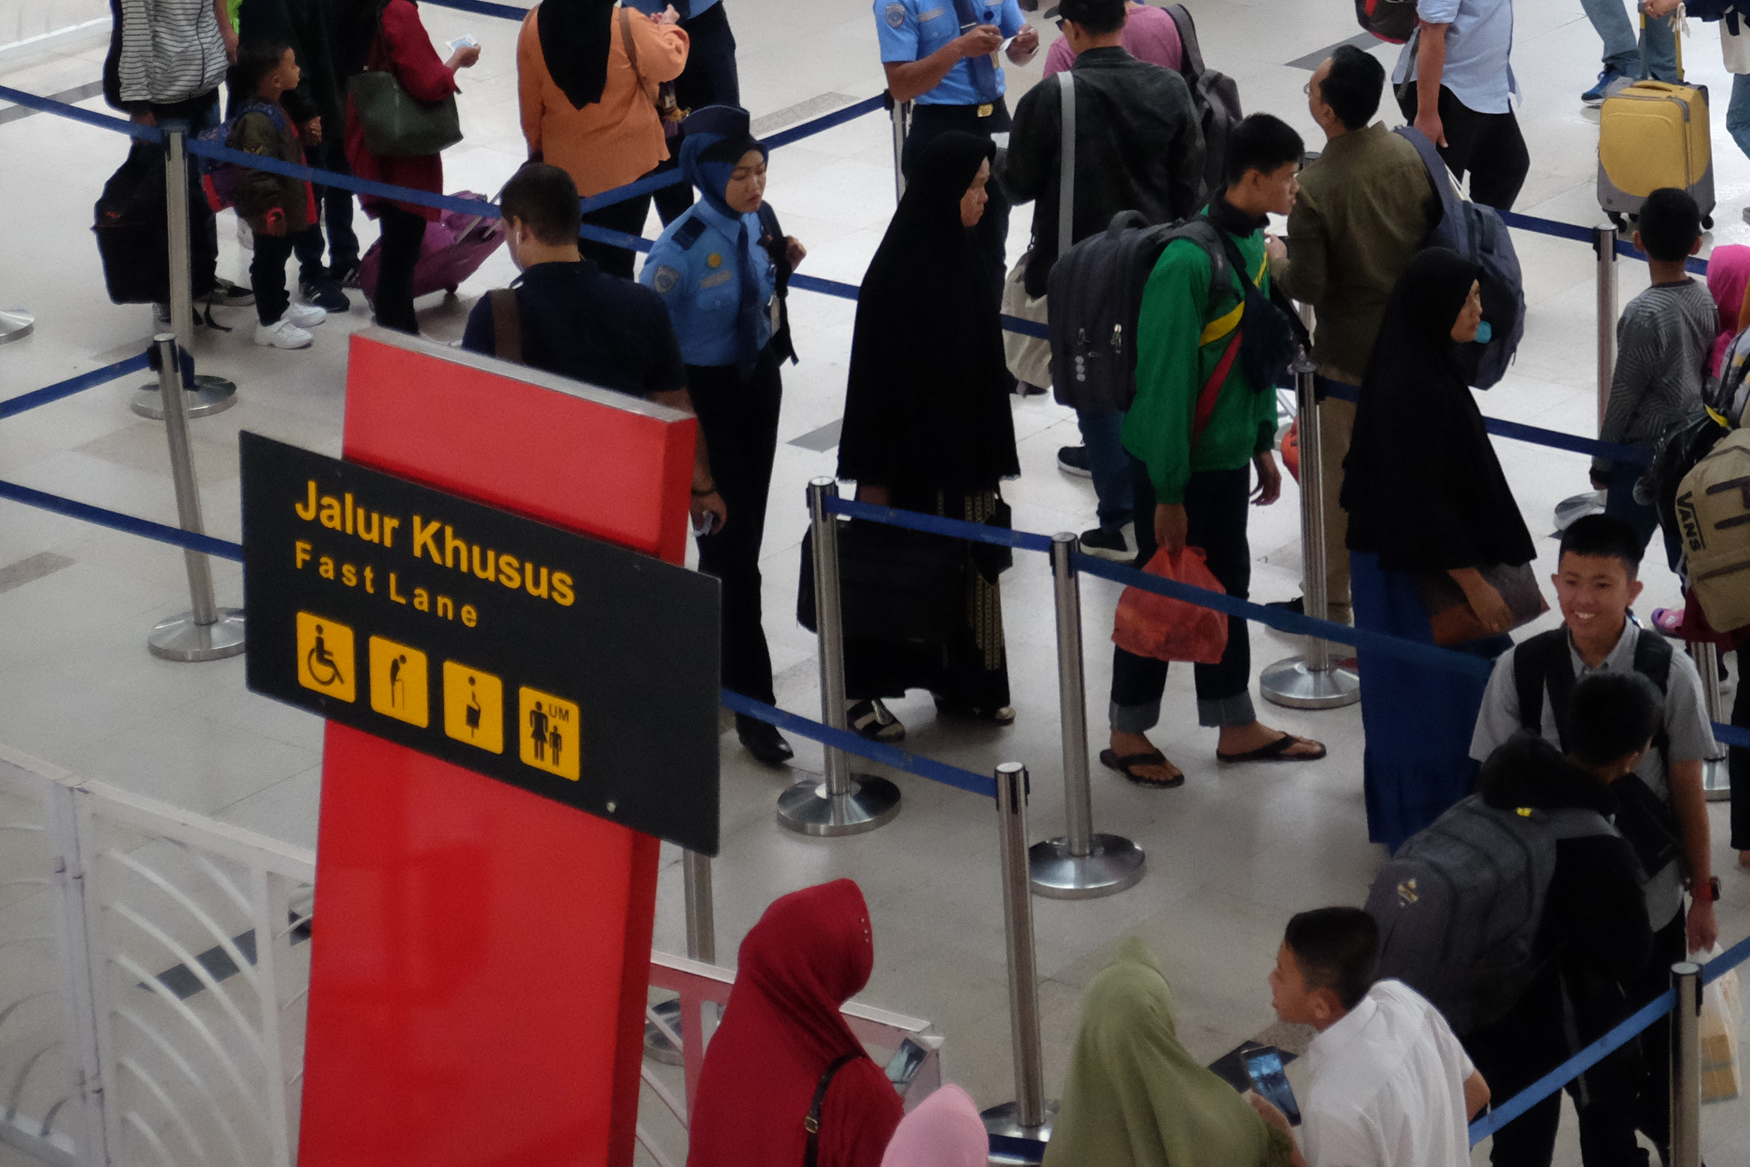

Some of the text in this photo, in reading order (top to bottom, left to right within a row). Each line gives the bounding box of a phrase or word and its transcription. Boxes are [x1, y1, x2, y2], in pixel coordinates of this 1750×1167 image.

[295, 480, 576, 607] Jalur Khusus
[1676, 490, 1706, 552] VANS
[295, 541, 478, 627] Fast Lane
[547, 703, 570, 723] UM
